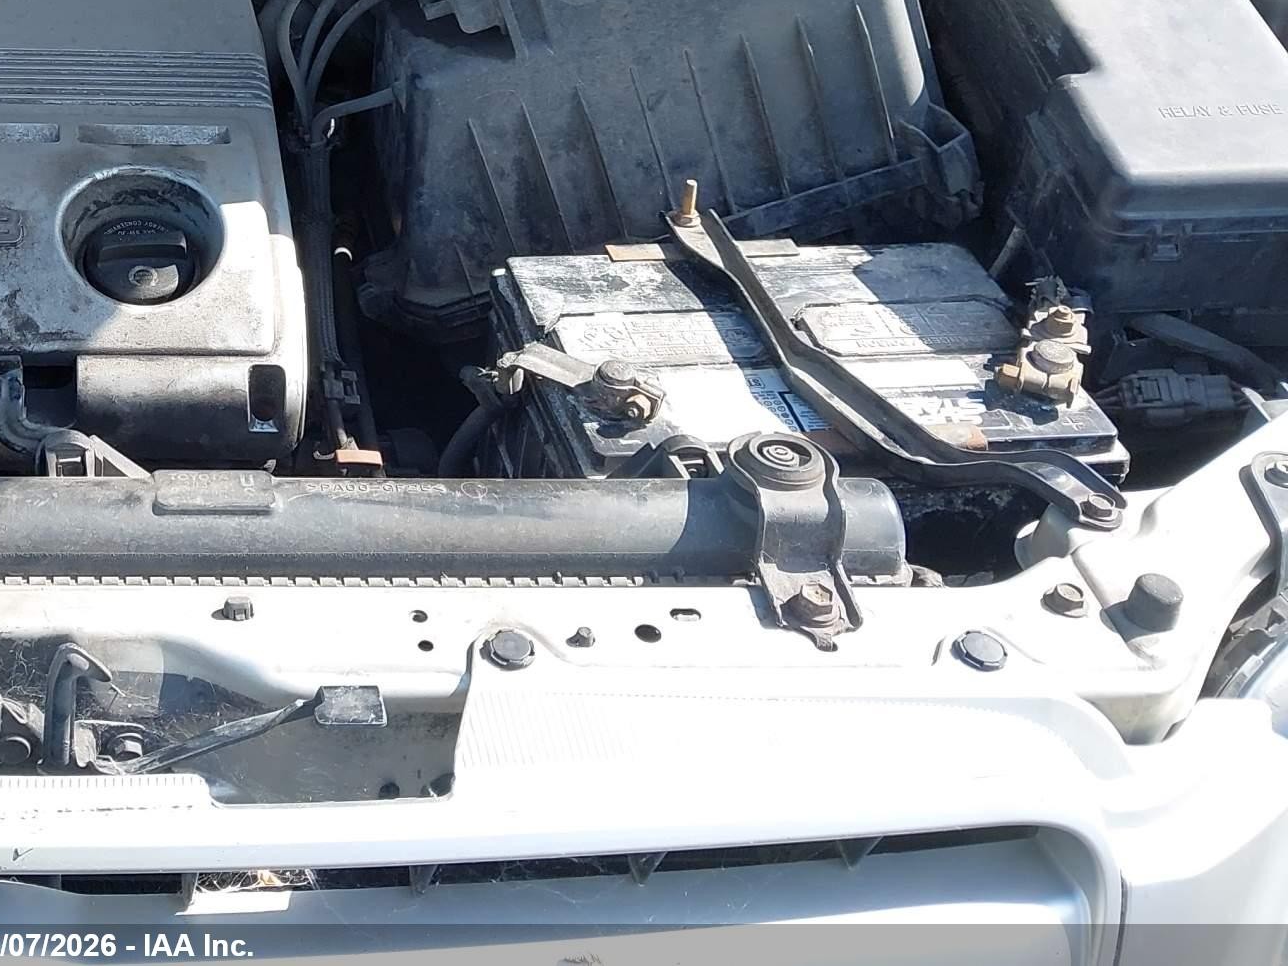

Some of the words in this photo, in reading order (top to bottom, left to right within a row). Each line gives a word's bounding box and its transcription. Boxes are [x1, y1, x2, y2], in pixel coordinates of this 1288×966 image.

[1158, 105, 1212, 119] RELAY
[1217, 105, 1233, 117] &
[1235, 103, 1284, 116] FUSE
